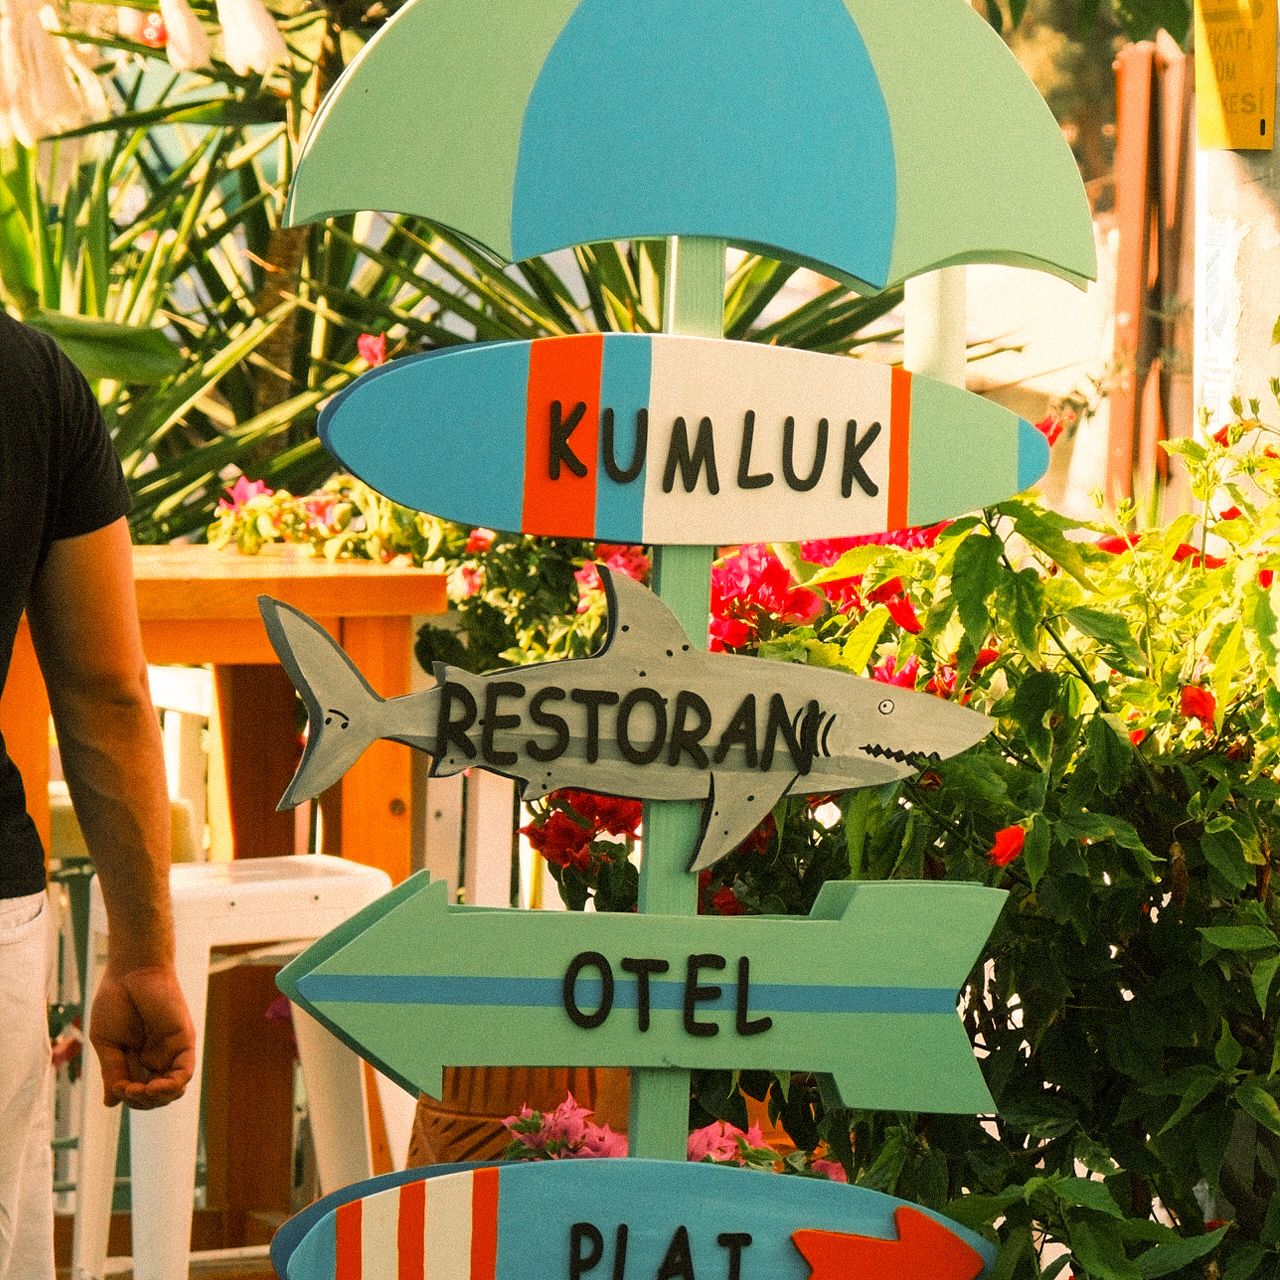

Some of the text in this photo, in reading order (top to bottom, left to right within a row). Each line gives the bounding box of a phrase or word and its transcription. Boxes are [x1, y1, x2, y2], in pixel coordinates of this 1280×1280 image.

[547, 400, 882, 500] KUMLUK
[436, 681, 819, 775] RESTORAN
[562, 950, 773, 1036] OTEL
